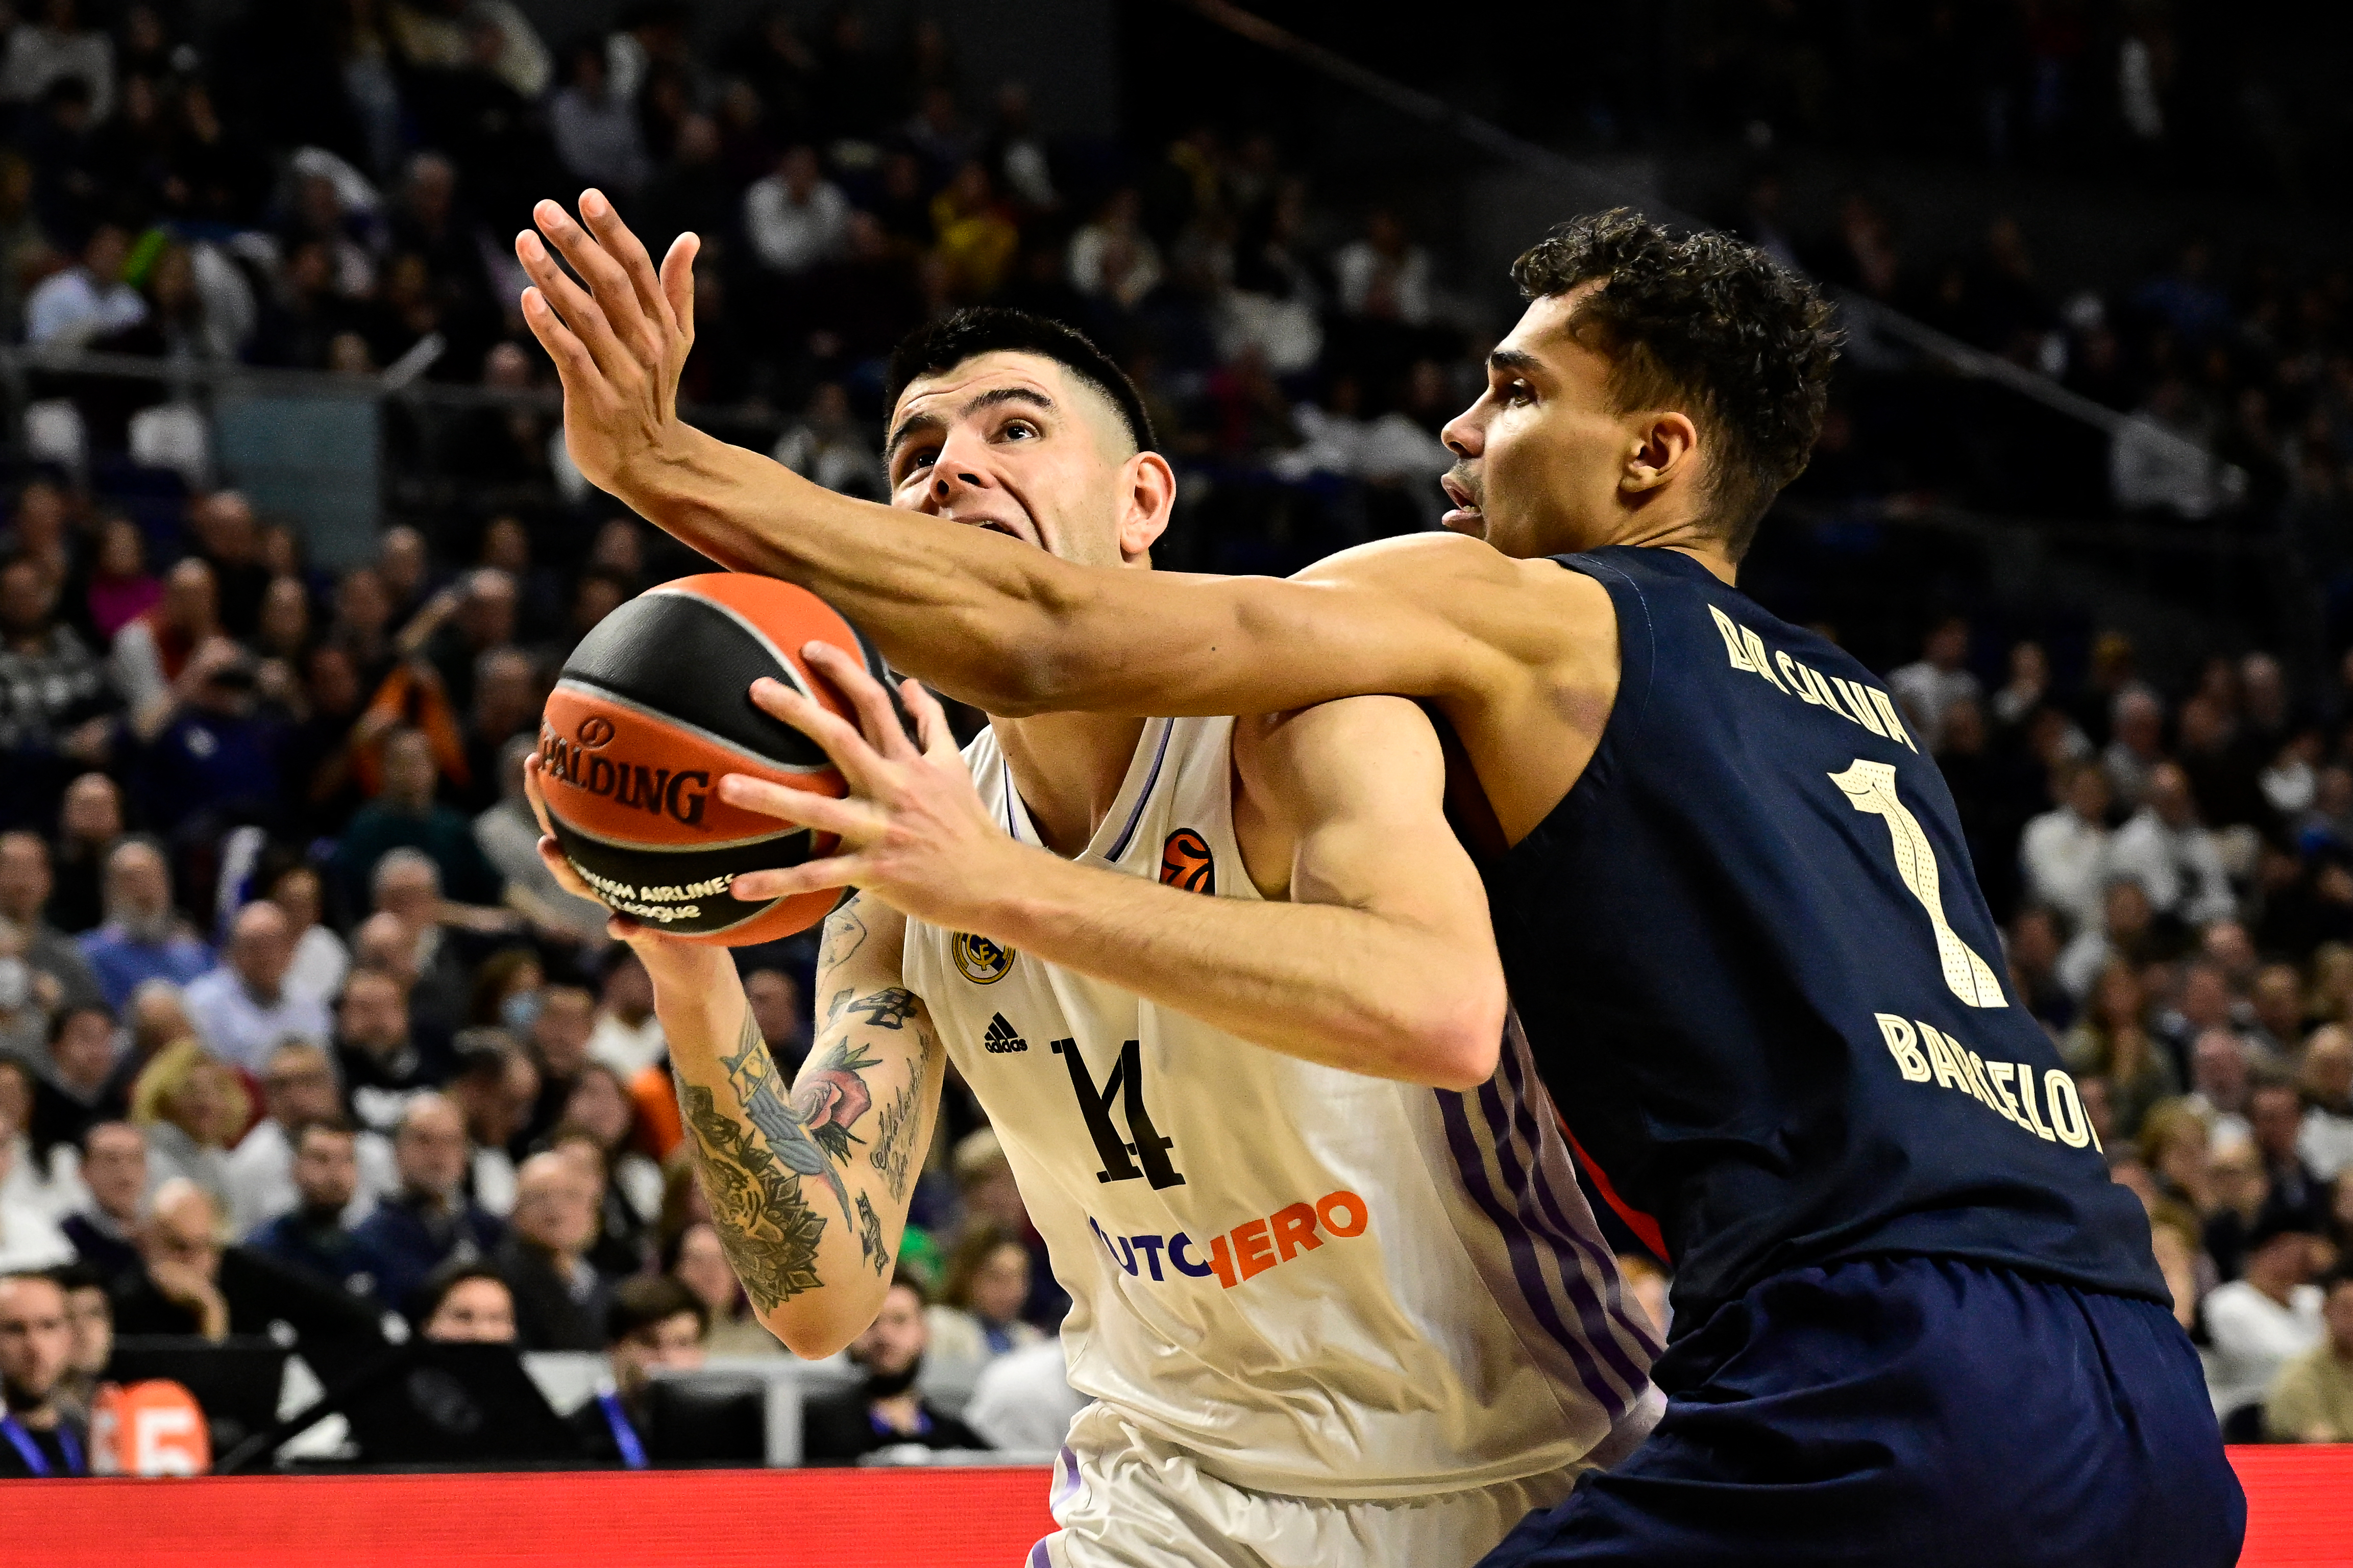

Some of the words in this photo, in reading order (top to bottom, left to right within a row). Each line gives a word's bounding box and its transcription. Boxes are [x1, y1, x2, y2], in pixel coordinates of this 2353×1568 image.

[1707, 603, 1792, 695] DA
[1775, 650, 1919, 755] SILVA
[1827, 759, 2009, 1008] 1
[985, 1038, 1028, 1054] adidas
[1050, 1037, 1186, 1190] 14
[1874, 1013, 2103, 1155] BARCELO
